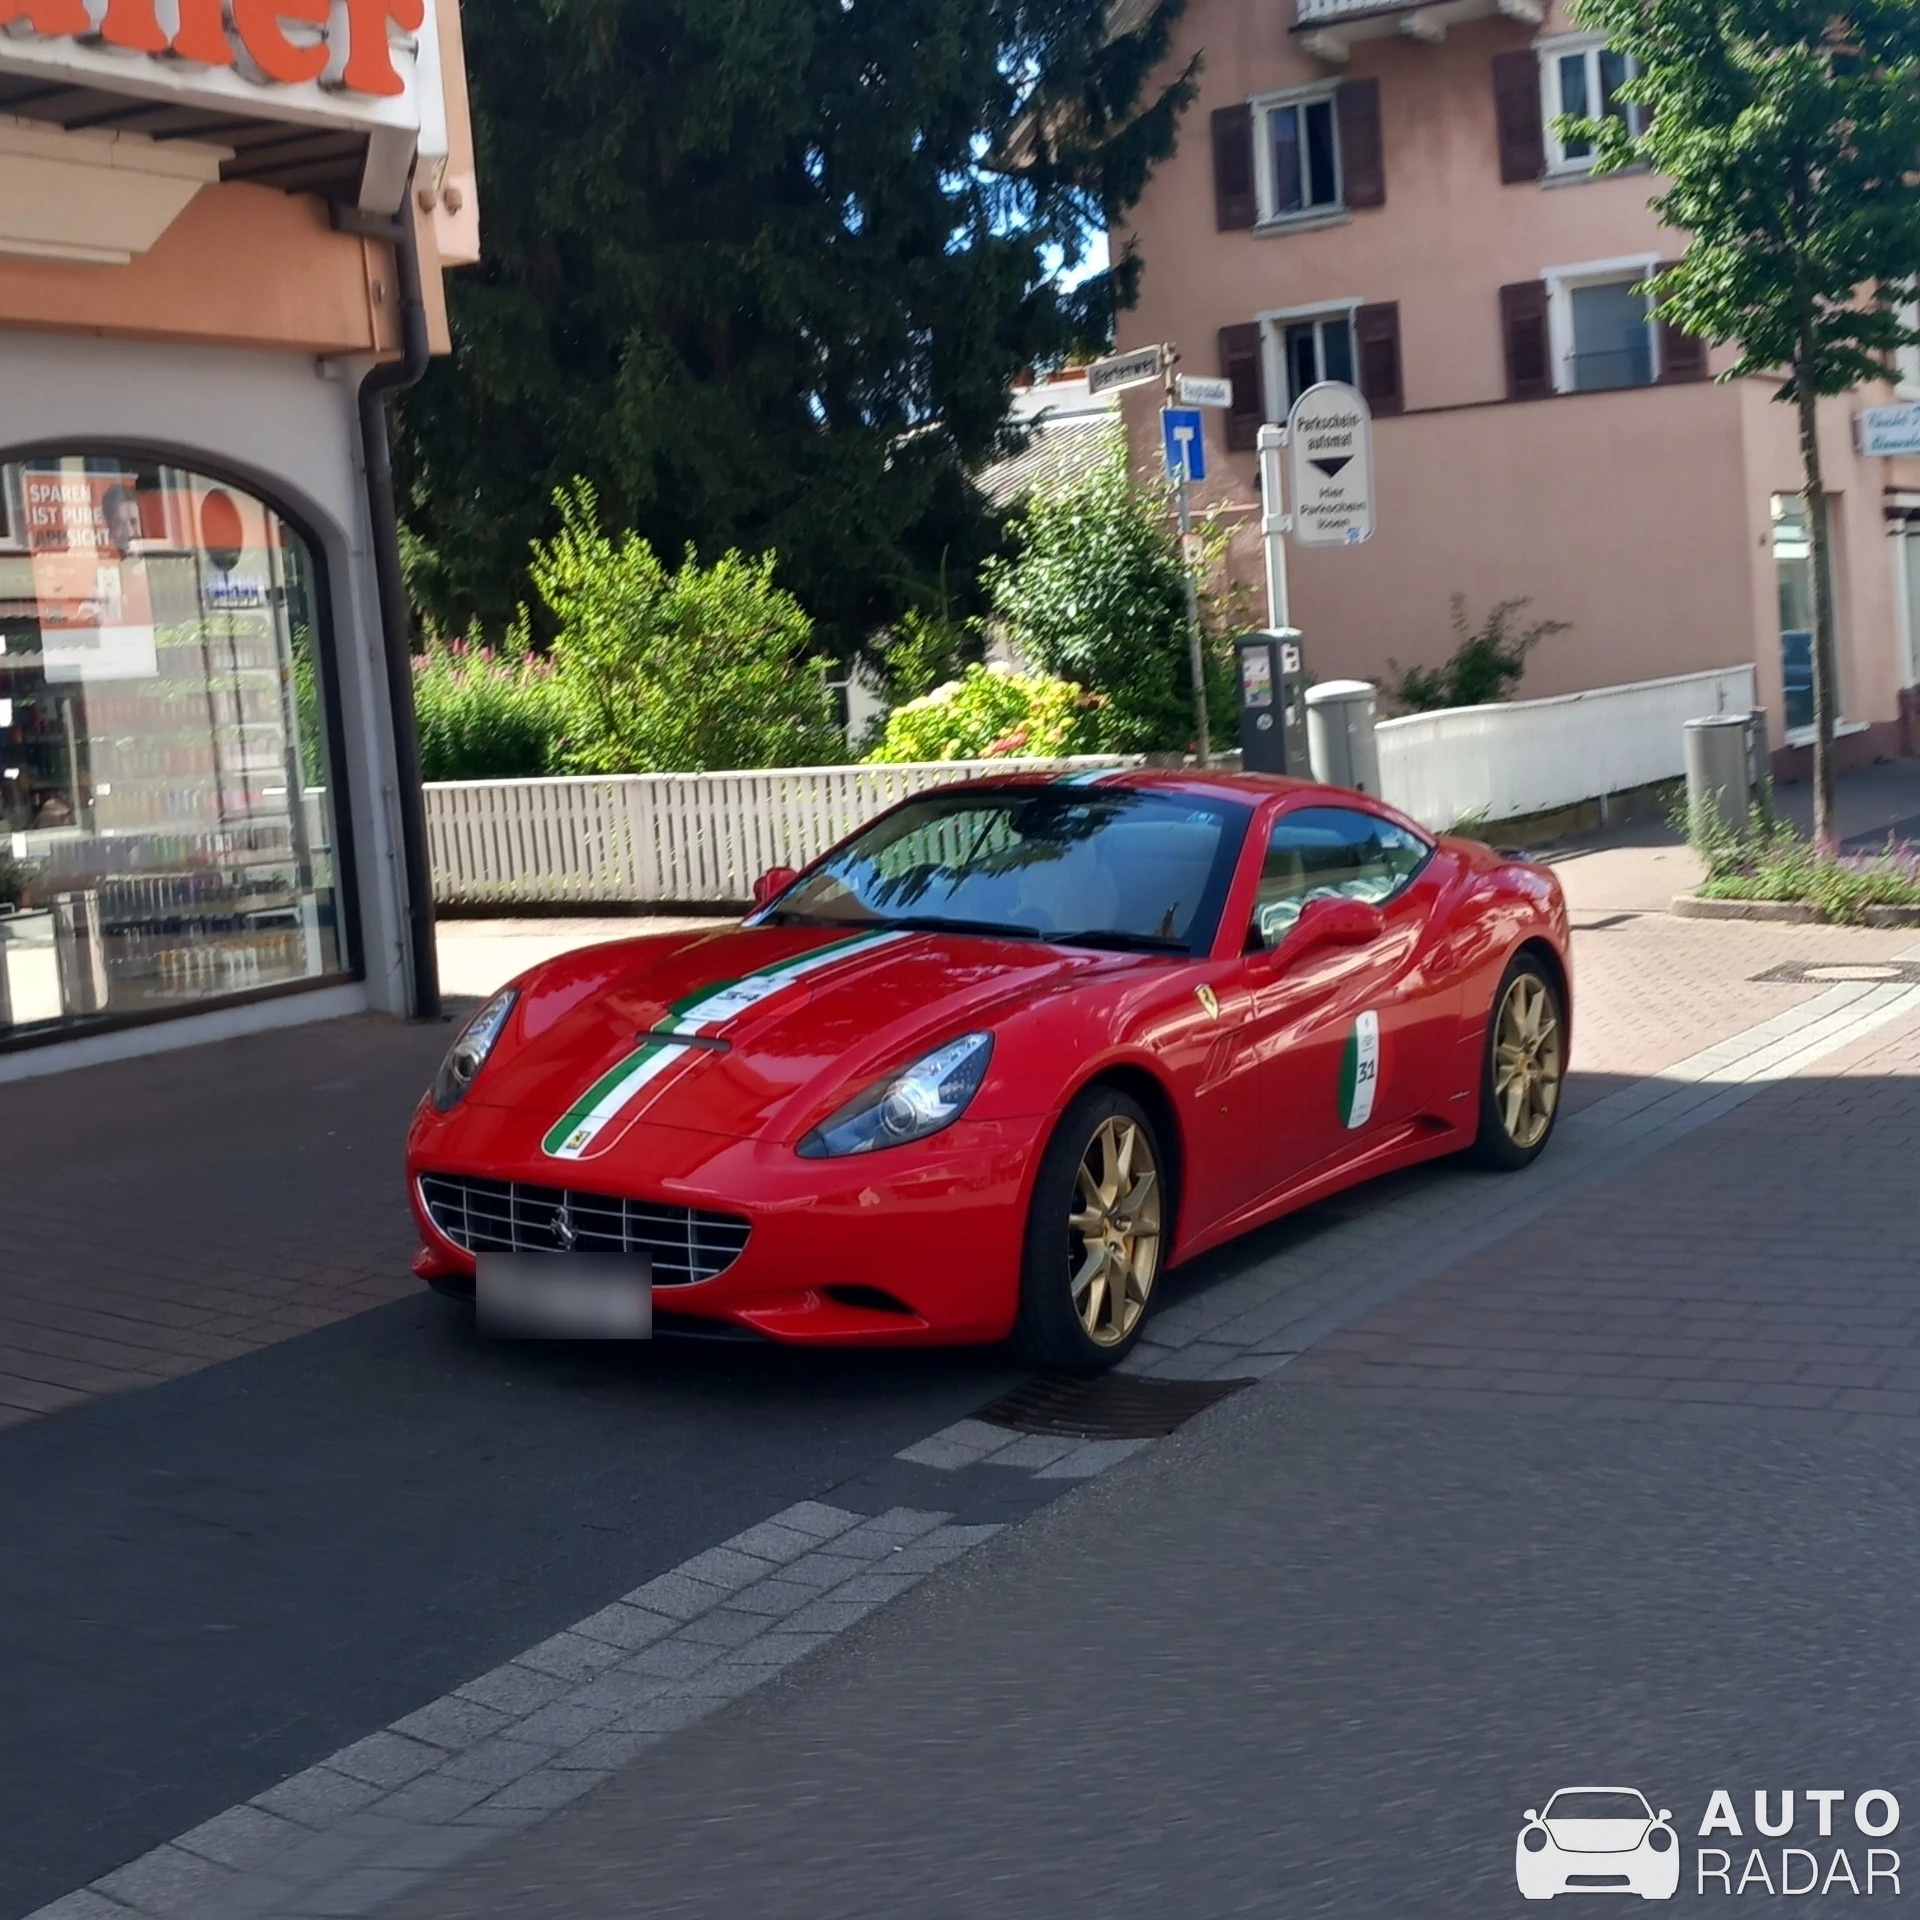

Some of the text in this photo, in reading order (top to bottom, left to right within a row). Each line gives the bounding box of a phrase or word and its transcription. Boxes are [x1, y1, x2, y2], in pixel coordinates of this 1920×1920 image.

[30, 484, 91, 502] SPAREN
[32, 507, 103, 525] IST PURE
[1357, 1059, 1375, 1084] 31
